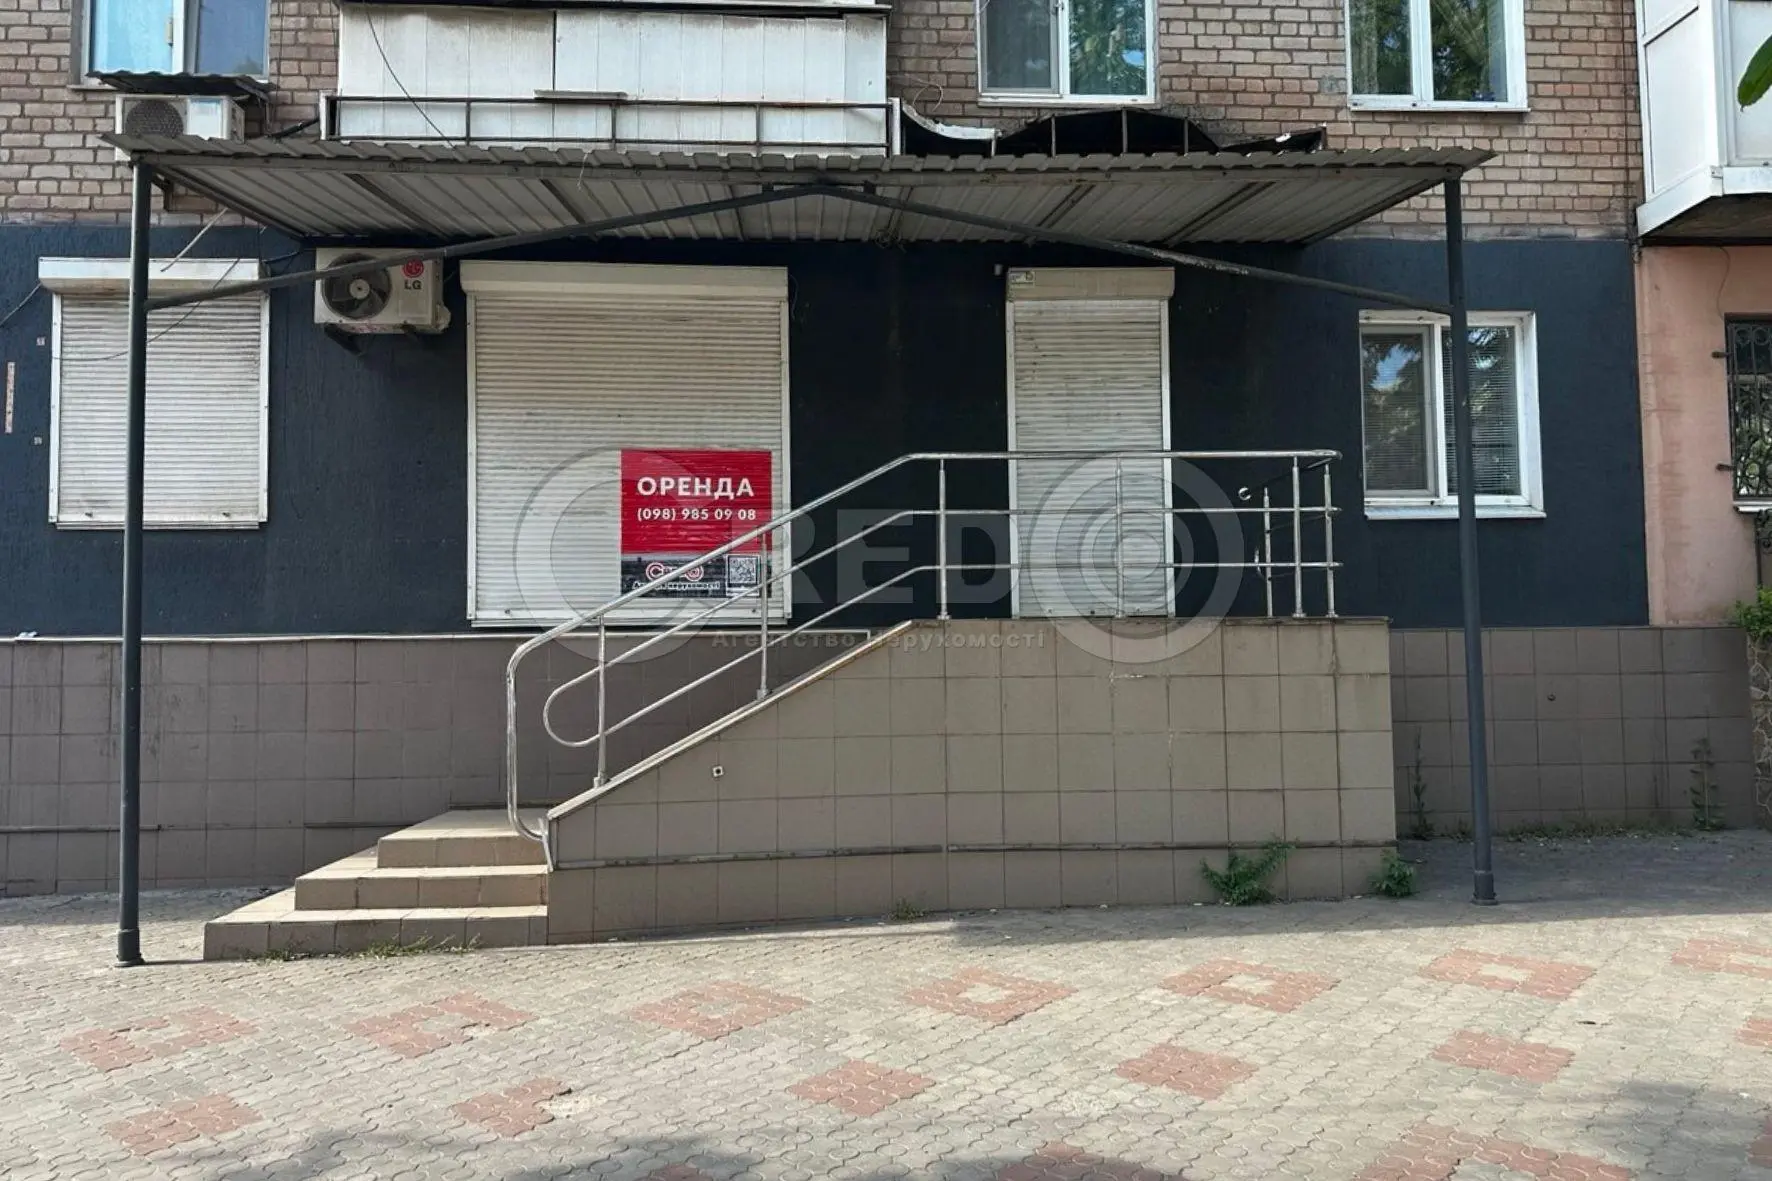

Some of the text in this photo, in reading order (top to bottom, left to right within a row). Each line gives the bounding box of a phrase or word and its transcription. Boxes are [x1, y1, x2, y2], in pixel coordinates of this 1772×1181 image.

[404, 280, 422, 290] LG
[636, 476, 755, 500] ОРЕНДА
[637, 508, 756, 521] (098) 985 09 08
